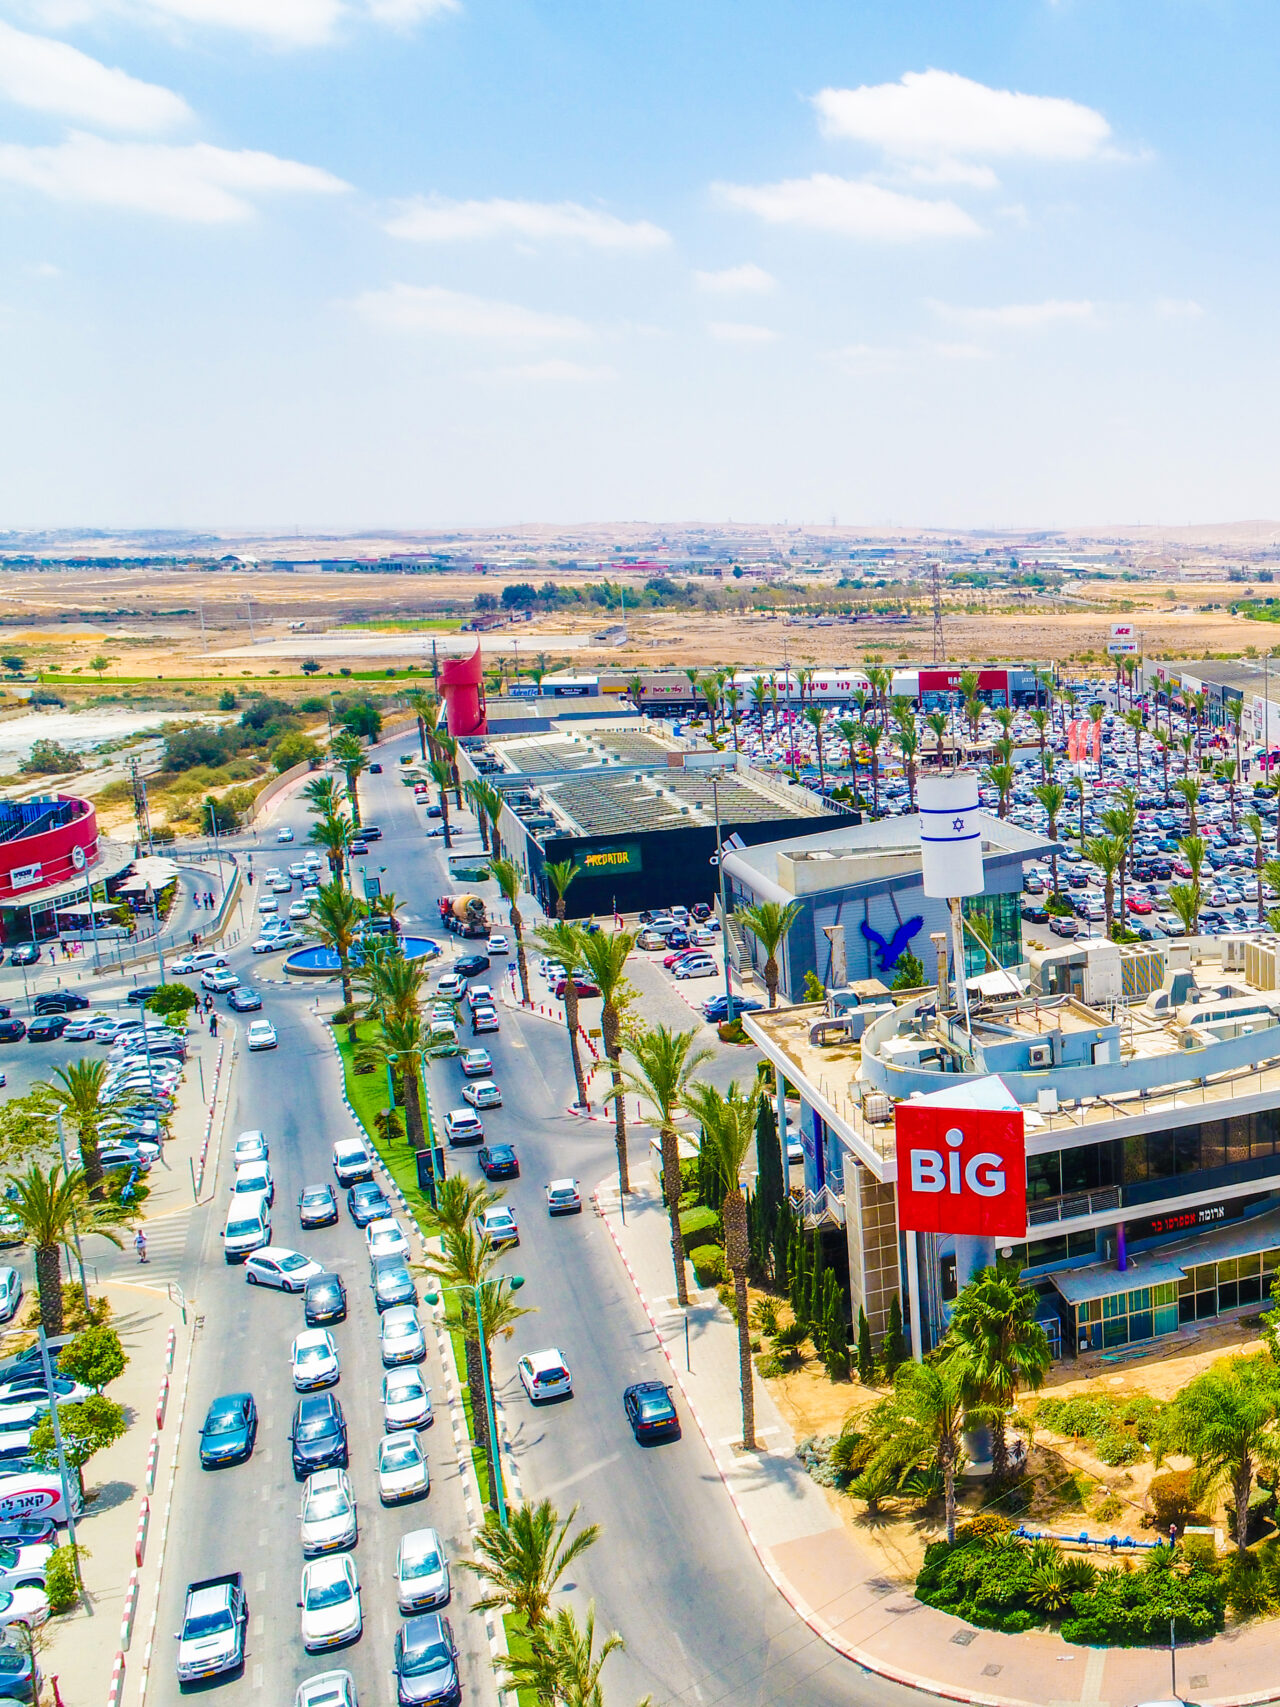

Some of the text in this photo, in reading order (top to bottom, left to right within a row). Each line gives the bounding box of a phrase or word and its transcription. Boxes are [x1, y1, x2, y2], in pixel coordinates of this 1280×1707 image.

[1115, 627, 1131, 635] ACE
[837, 680, 851, 690] לוי
[586, 851, 630, 867] PREDATOR
[1151, 1206, 1225, 1232] ארומה אספרסו בר
[17, 1494, 44, 1507] קאר
